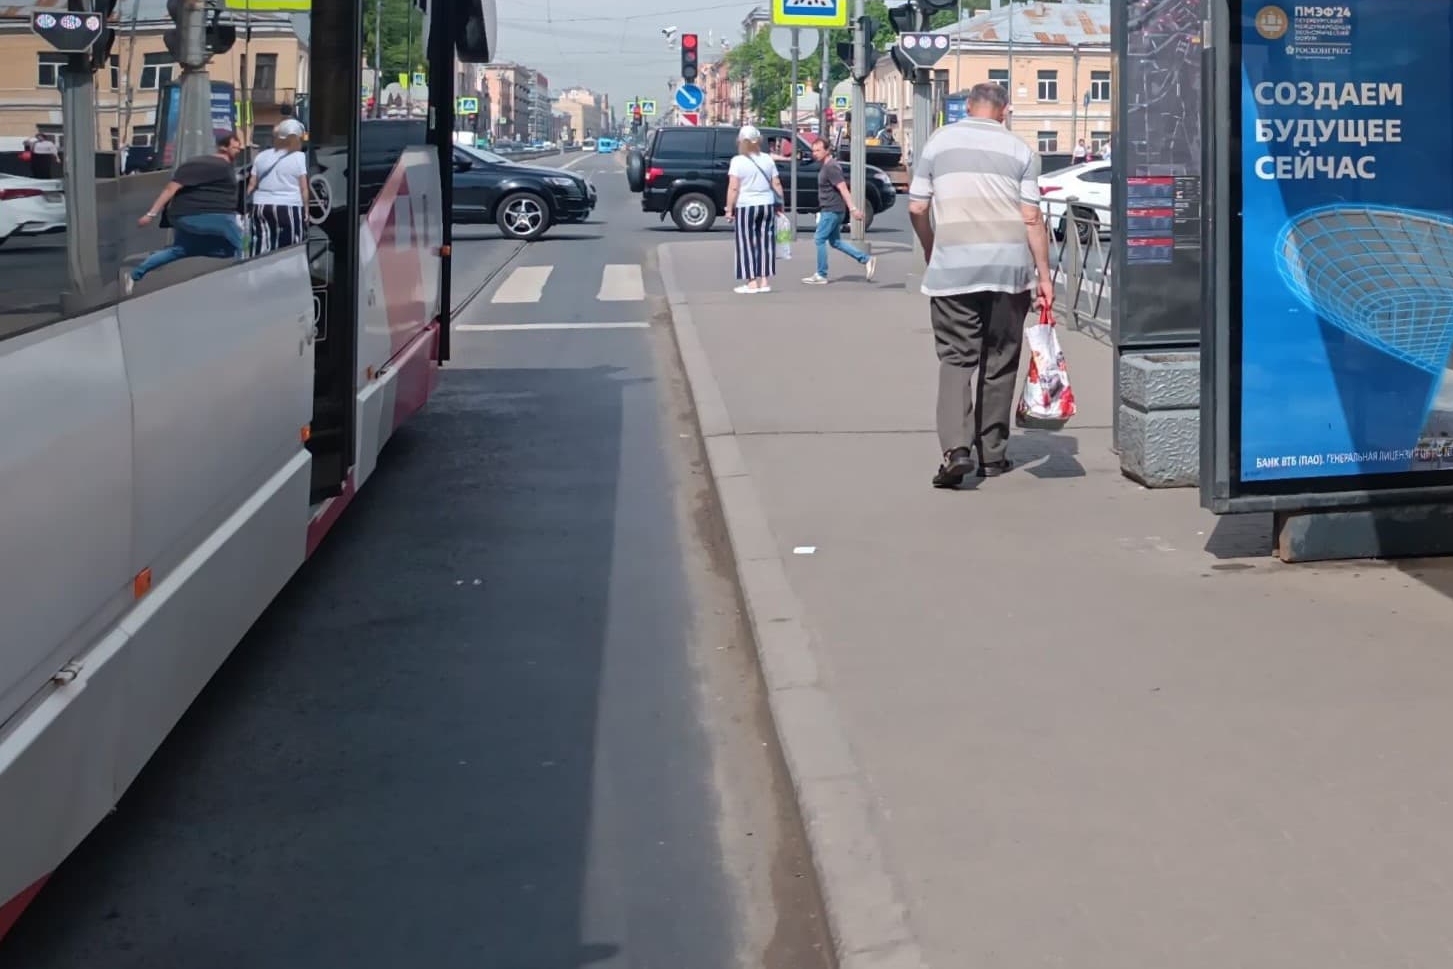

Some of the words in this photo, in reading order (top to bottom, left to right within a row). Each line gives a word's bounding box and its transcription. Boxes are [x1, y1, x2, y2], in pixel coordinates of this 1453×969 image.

[1254, 81, 1403, 110] СОЗДАЕМ
[1255, 118, 1402, 147] БУДУЩЕЕ
[1254, 150, 1376, 180] СЕЙЧАС
[1256, 457, 1279, 468] БАНК
[1281, 456, 1297, 467] ВТБ
